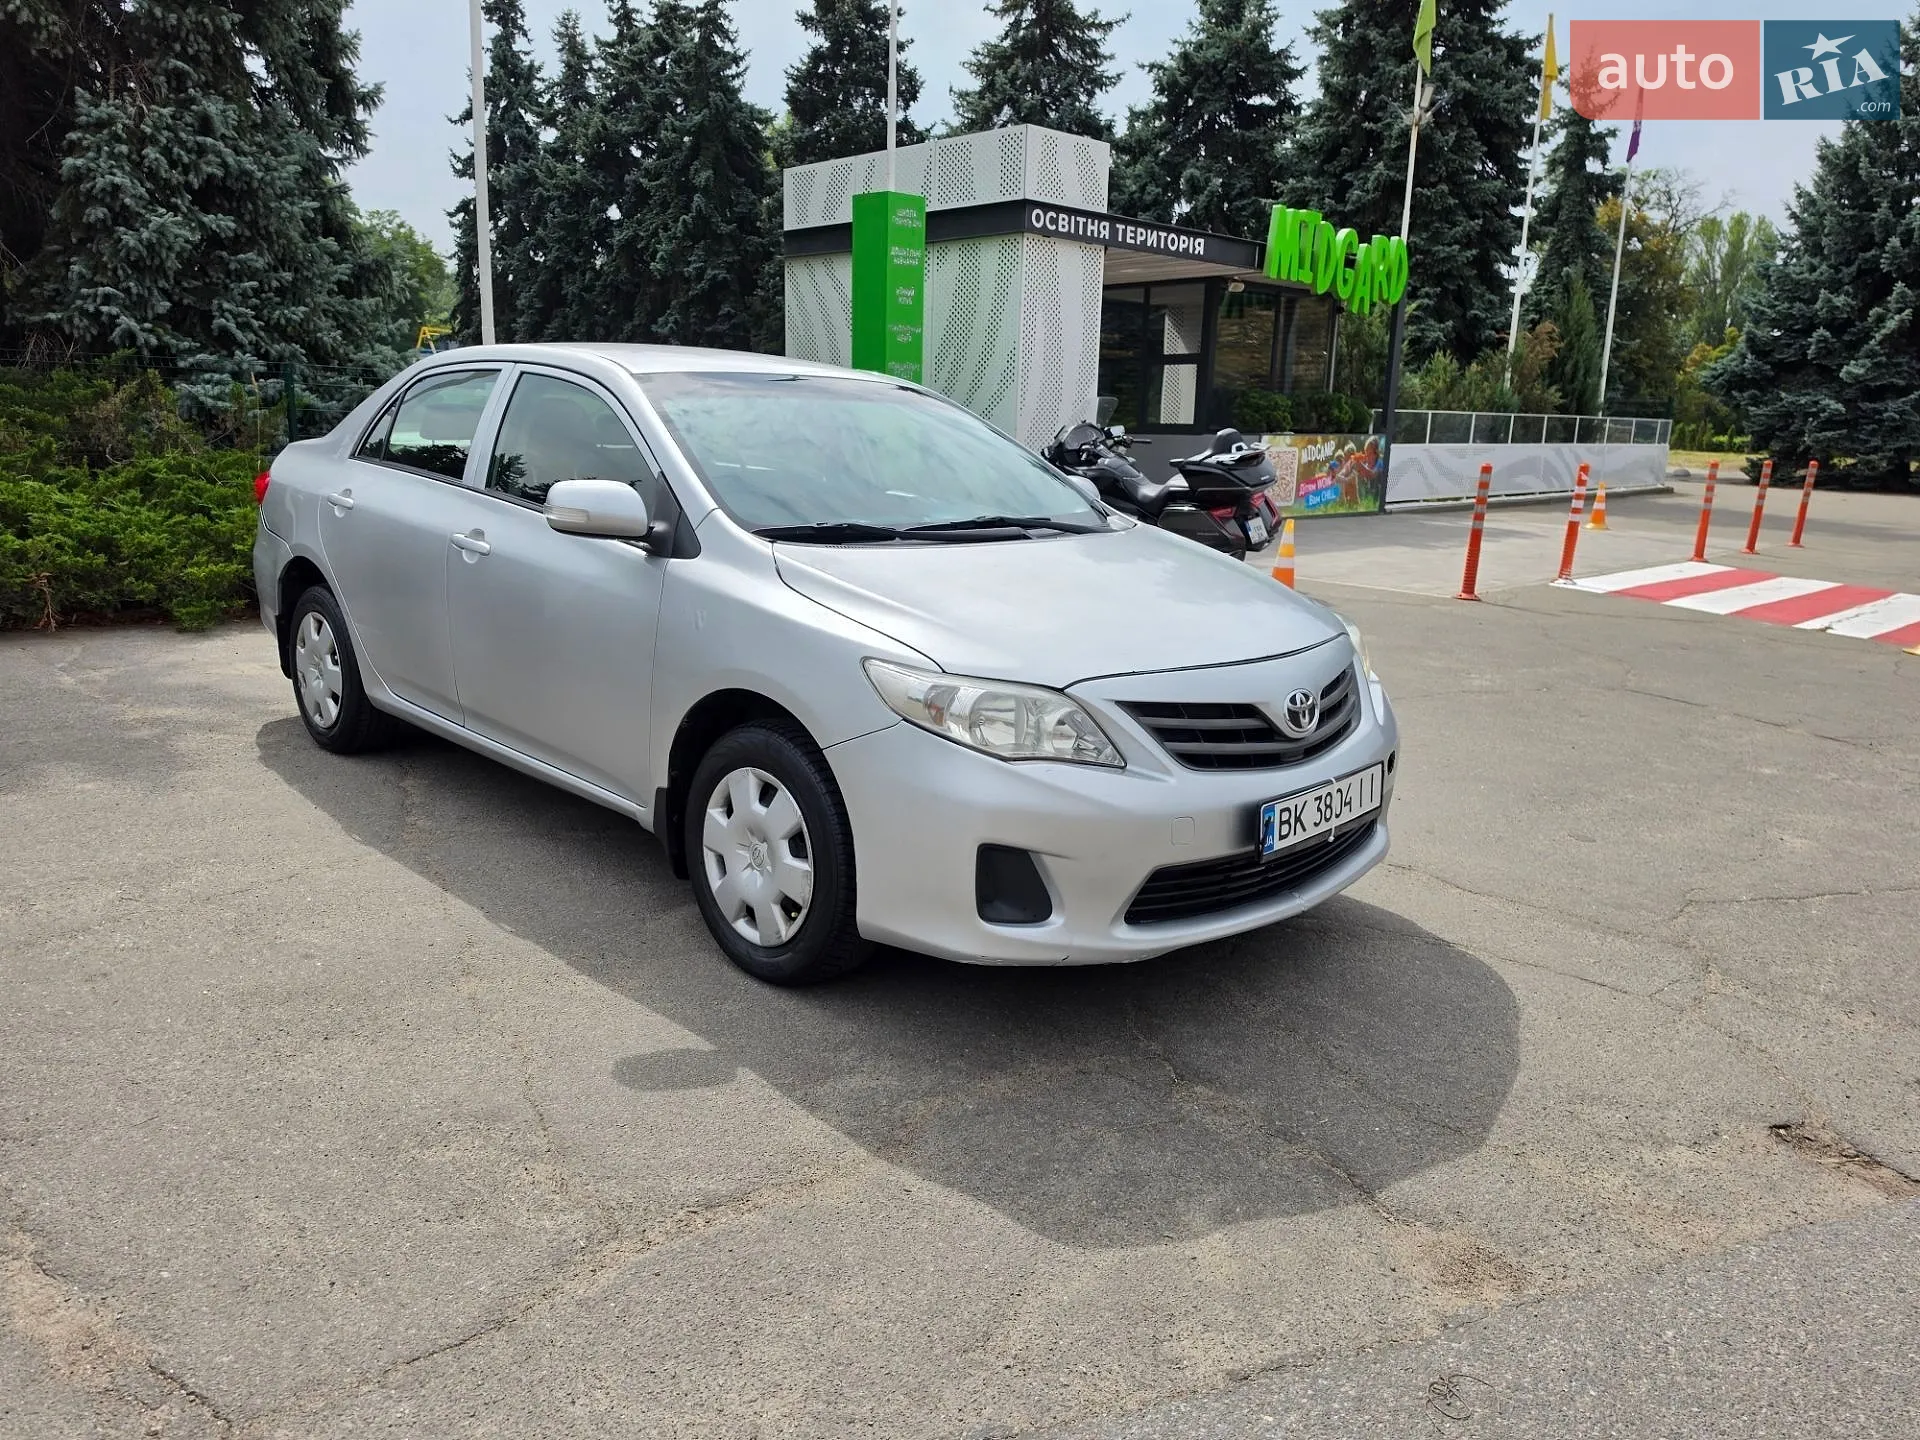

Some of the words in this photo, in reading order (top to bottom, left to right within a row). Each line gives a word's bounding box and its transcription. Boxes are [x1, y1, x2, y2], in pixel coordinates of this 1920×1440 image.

[1031, 207, 1109, 240] ОСВІТНЯ
[1115, 222, 1206, 257] ТЕРИТОРІЯ
[1265, 204, 1410, 315] MIDGARD
[1278, 799, 1308, 842] BK
